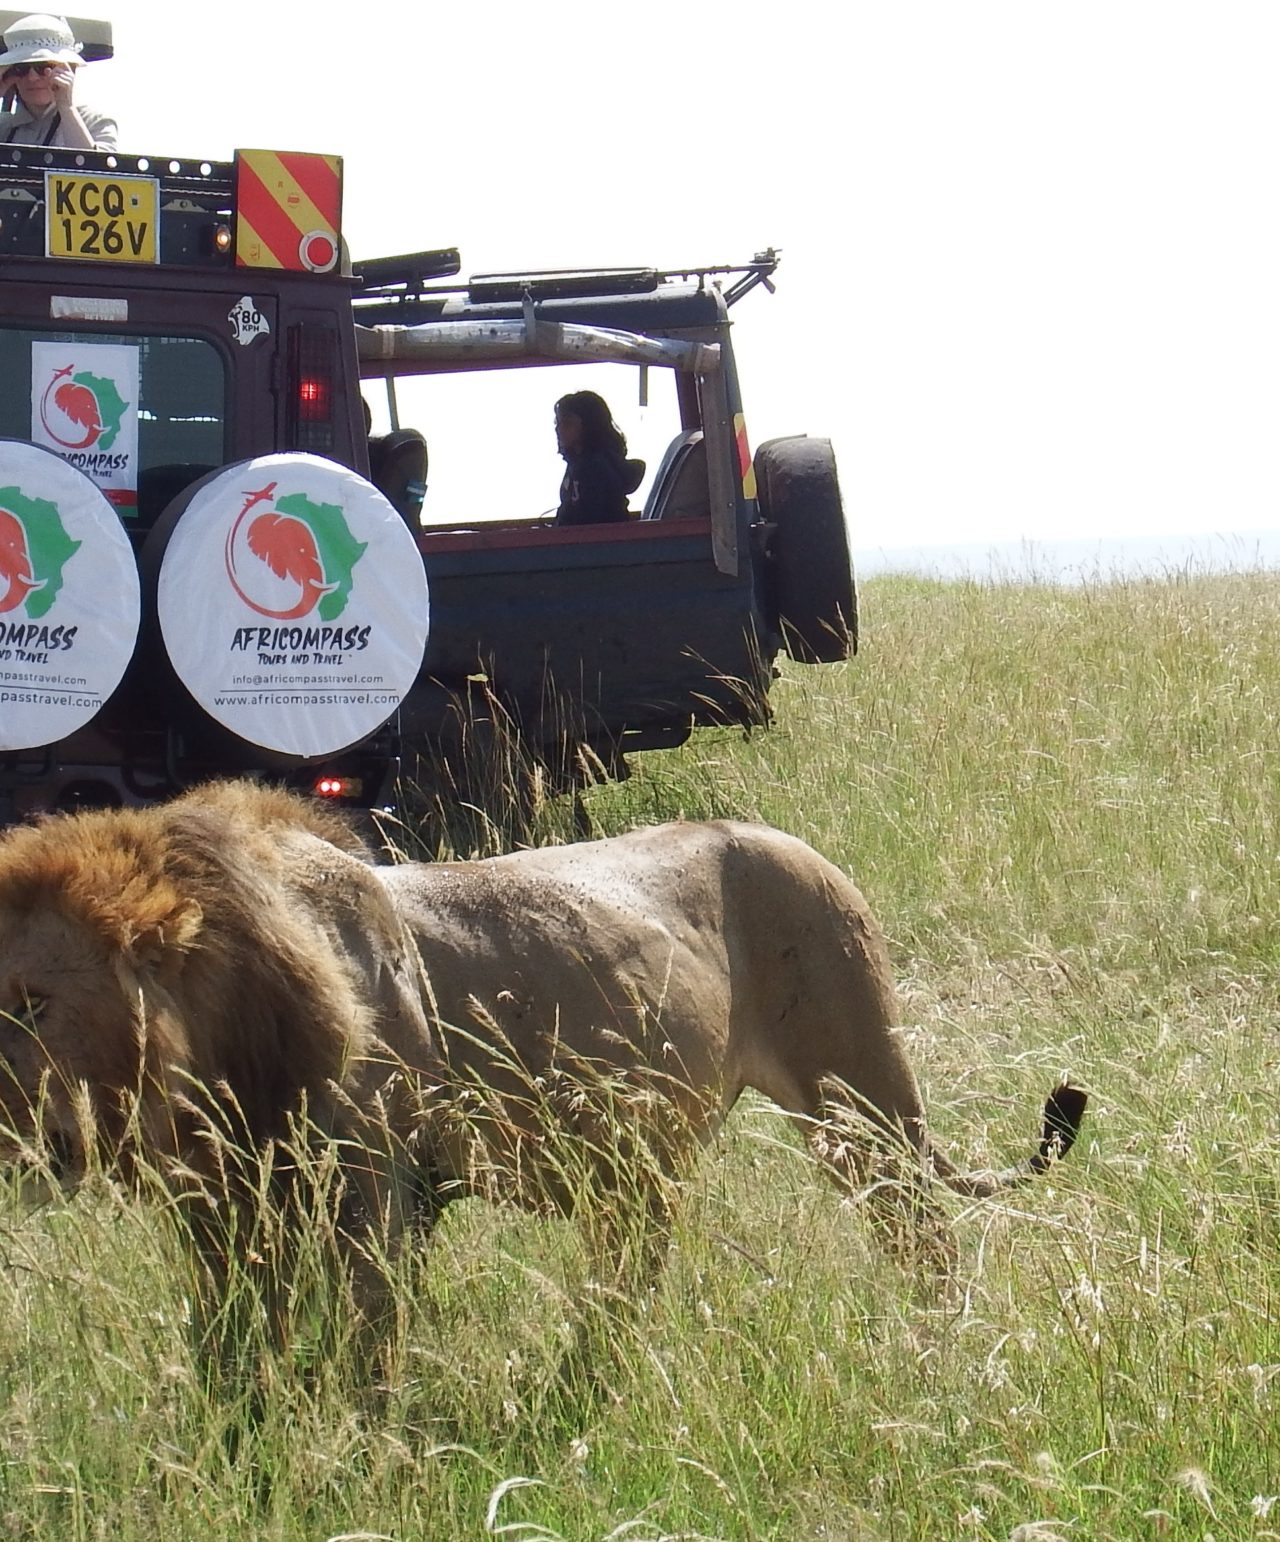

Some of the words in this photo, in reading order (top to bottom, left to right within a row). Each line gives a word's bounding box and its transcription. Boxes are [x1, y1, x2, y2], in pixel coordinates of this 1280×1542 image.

[55, 180, 125, 217] KCQ
[62, 218, 148, 255] 126V
[242, 310, 261, 324] 80
[242, 324, 260, 332] KPH
[230, 625, 372, 651] AFRICOMPASS
[15, 649, 49, 664] TRAVEL
[257, 653, 287, 665] TOURS
[291, 653, 310, 665] AND
[313, 653, 343, 665] TRAVEL
[232, 674, 383, 686] info@africompasstravel.com
[214, 693, 400, 706] www.africompasstravel.com
